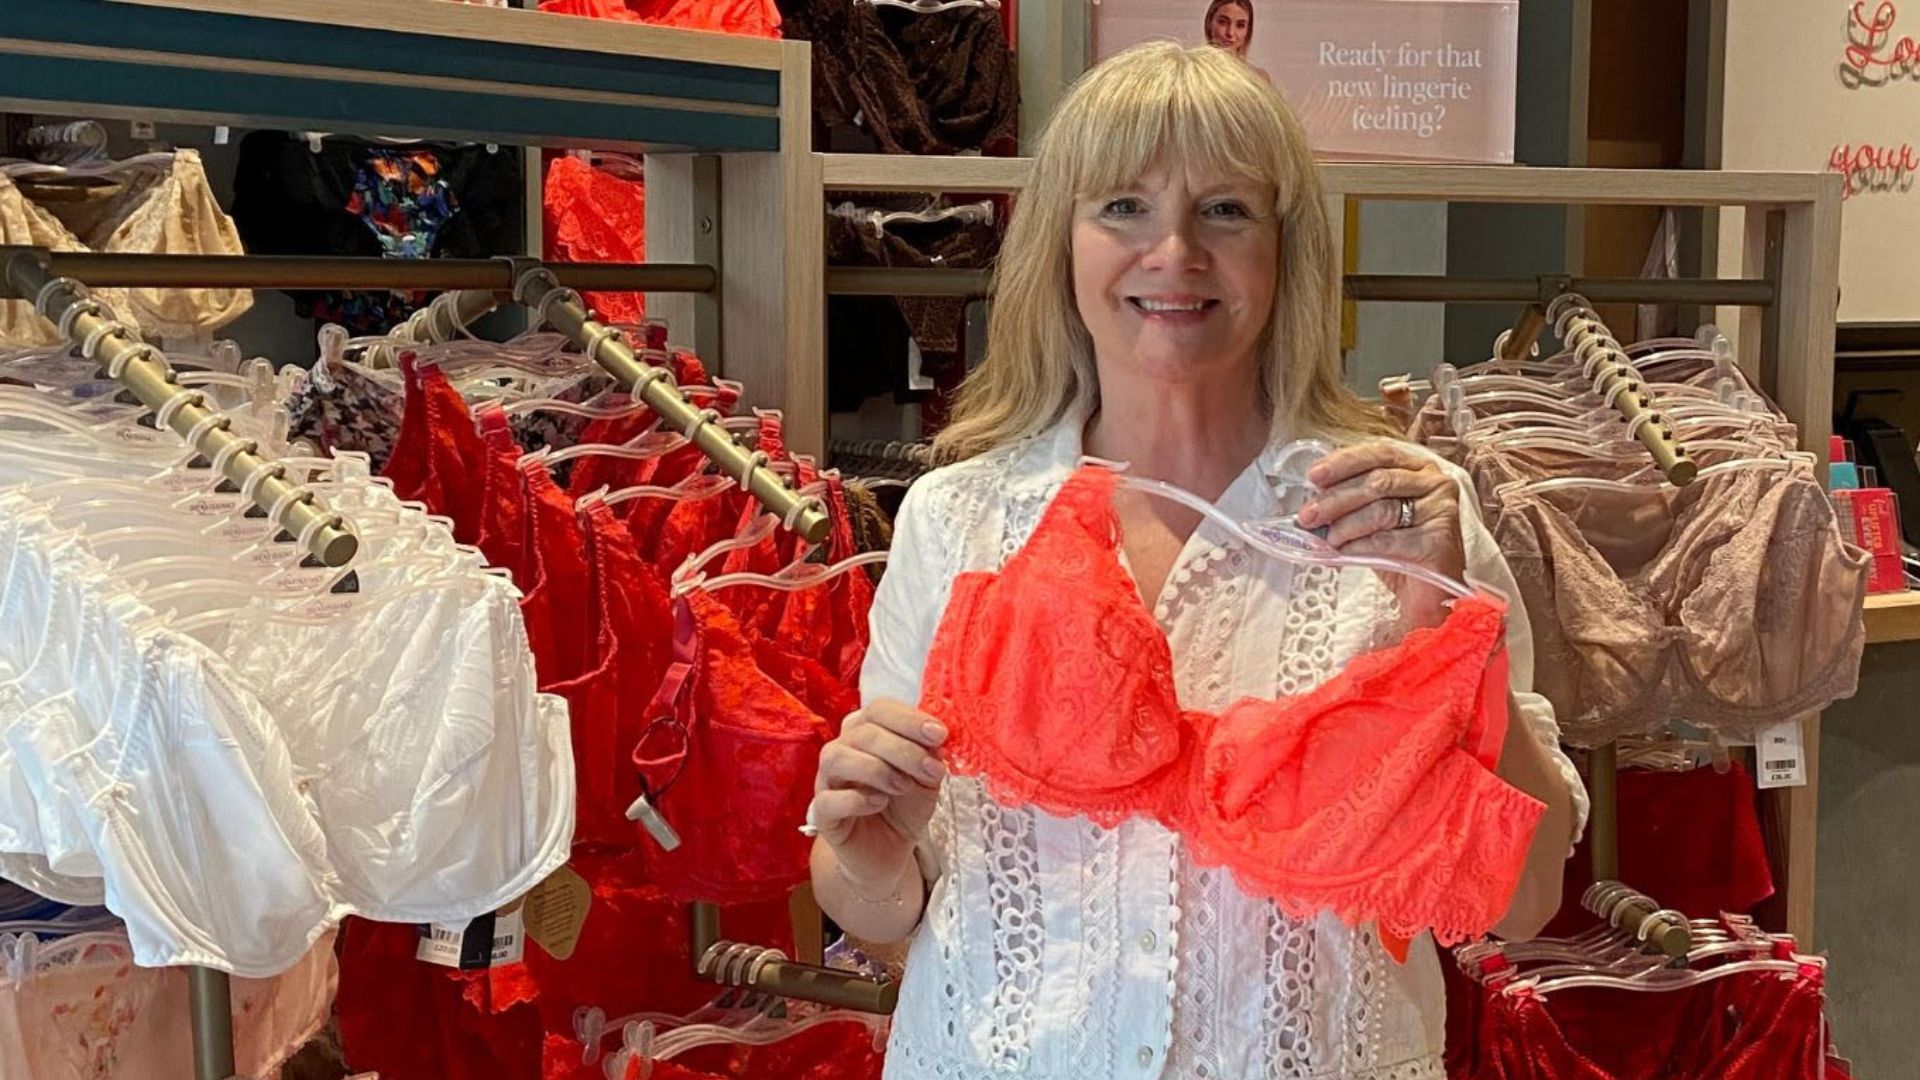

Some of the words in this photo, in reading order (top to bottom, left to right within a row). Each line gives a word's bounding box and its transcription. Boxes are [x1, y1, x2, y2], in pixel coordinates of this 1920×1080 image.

[1846, 1, 1920, 69] Lo
[1319, 41, 1391, 72] Ready
[1399, 42, 1433, 67] for
[1437, 43, 1482, 68] that
[1328, 78, 1377, 97] new
[1383, 74, 1472, 103] lingerie
[1352, 105, 1446, 137] feeling?
